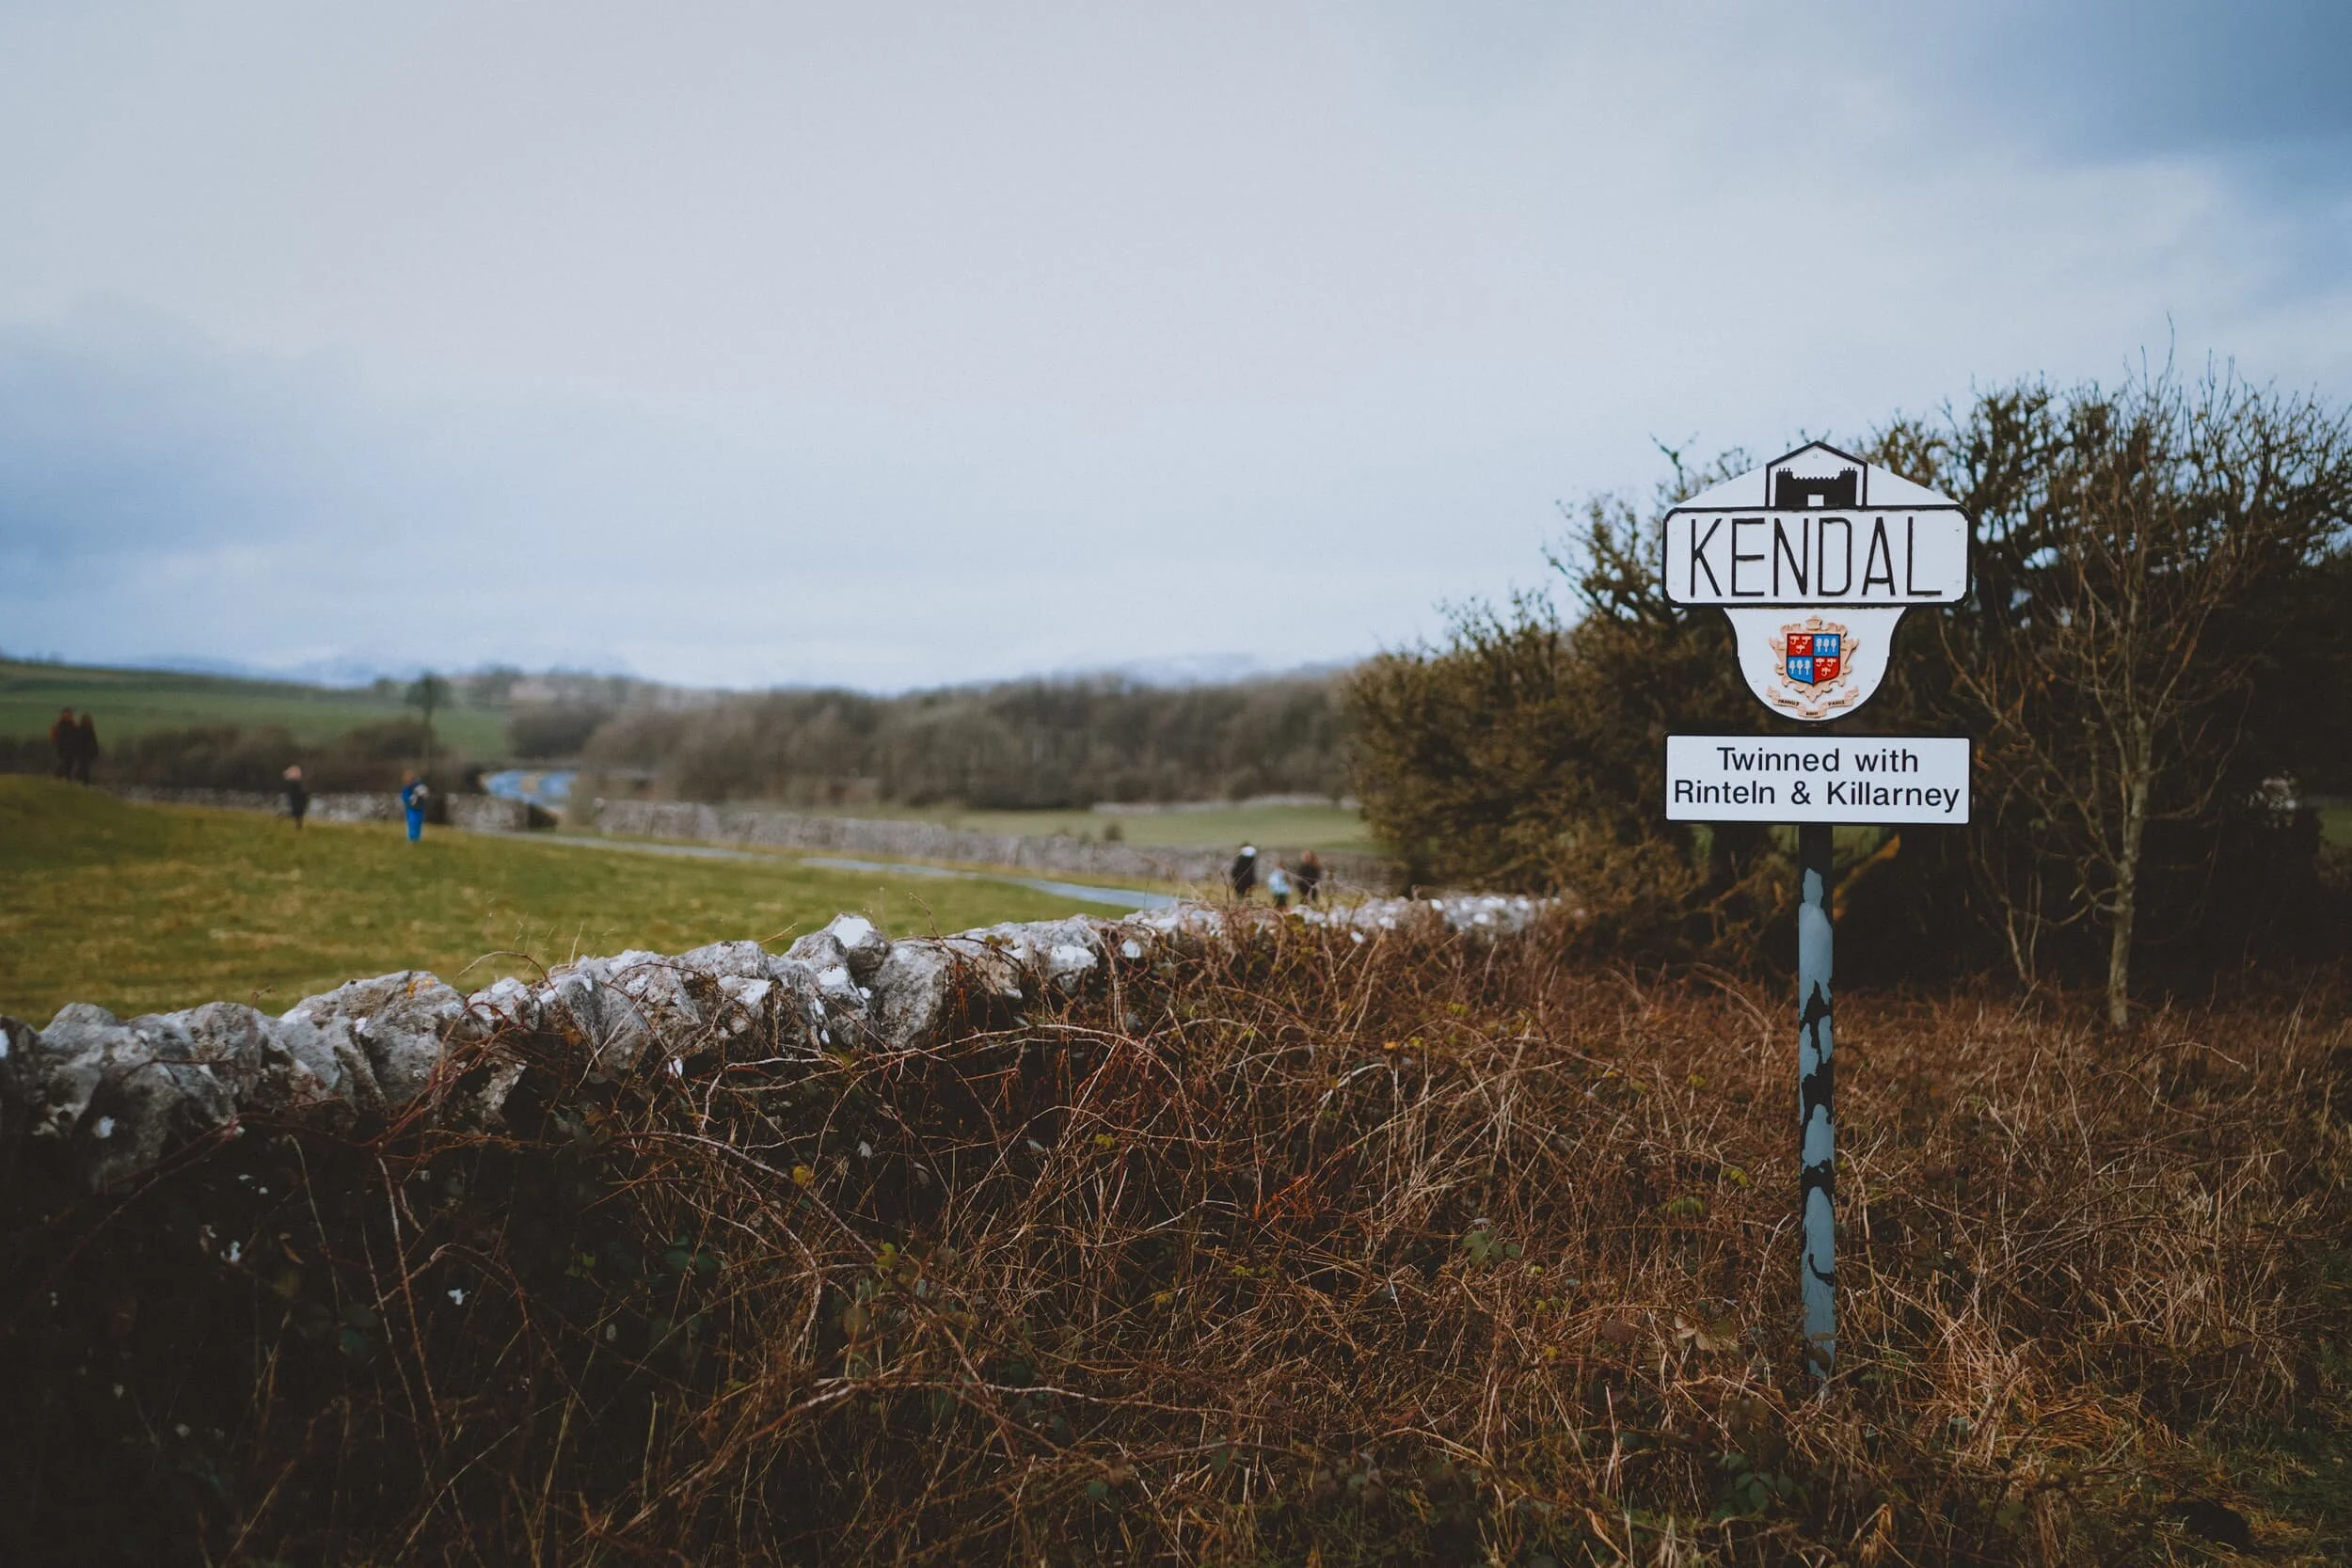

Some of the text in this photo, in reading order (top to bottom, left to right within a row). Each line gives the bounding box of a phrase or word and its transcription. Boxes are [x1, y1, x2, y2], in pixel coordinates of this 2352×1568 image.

[1690, 516, 1943, 597] KENDAL
[1717, 747, 1918, 773] Twinned with
[1675, 780, 1960, 814] Rinteln & Killarney
